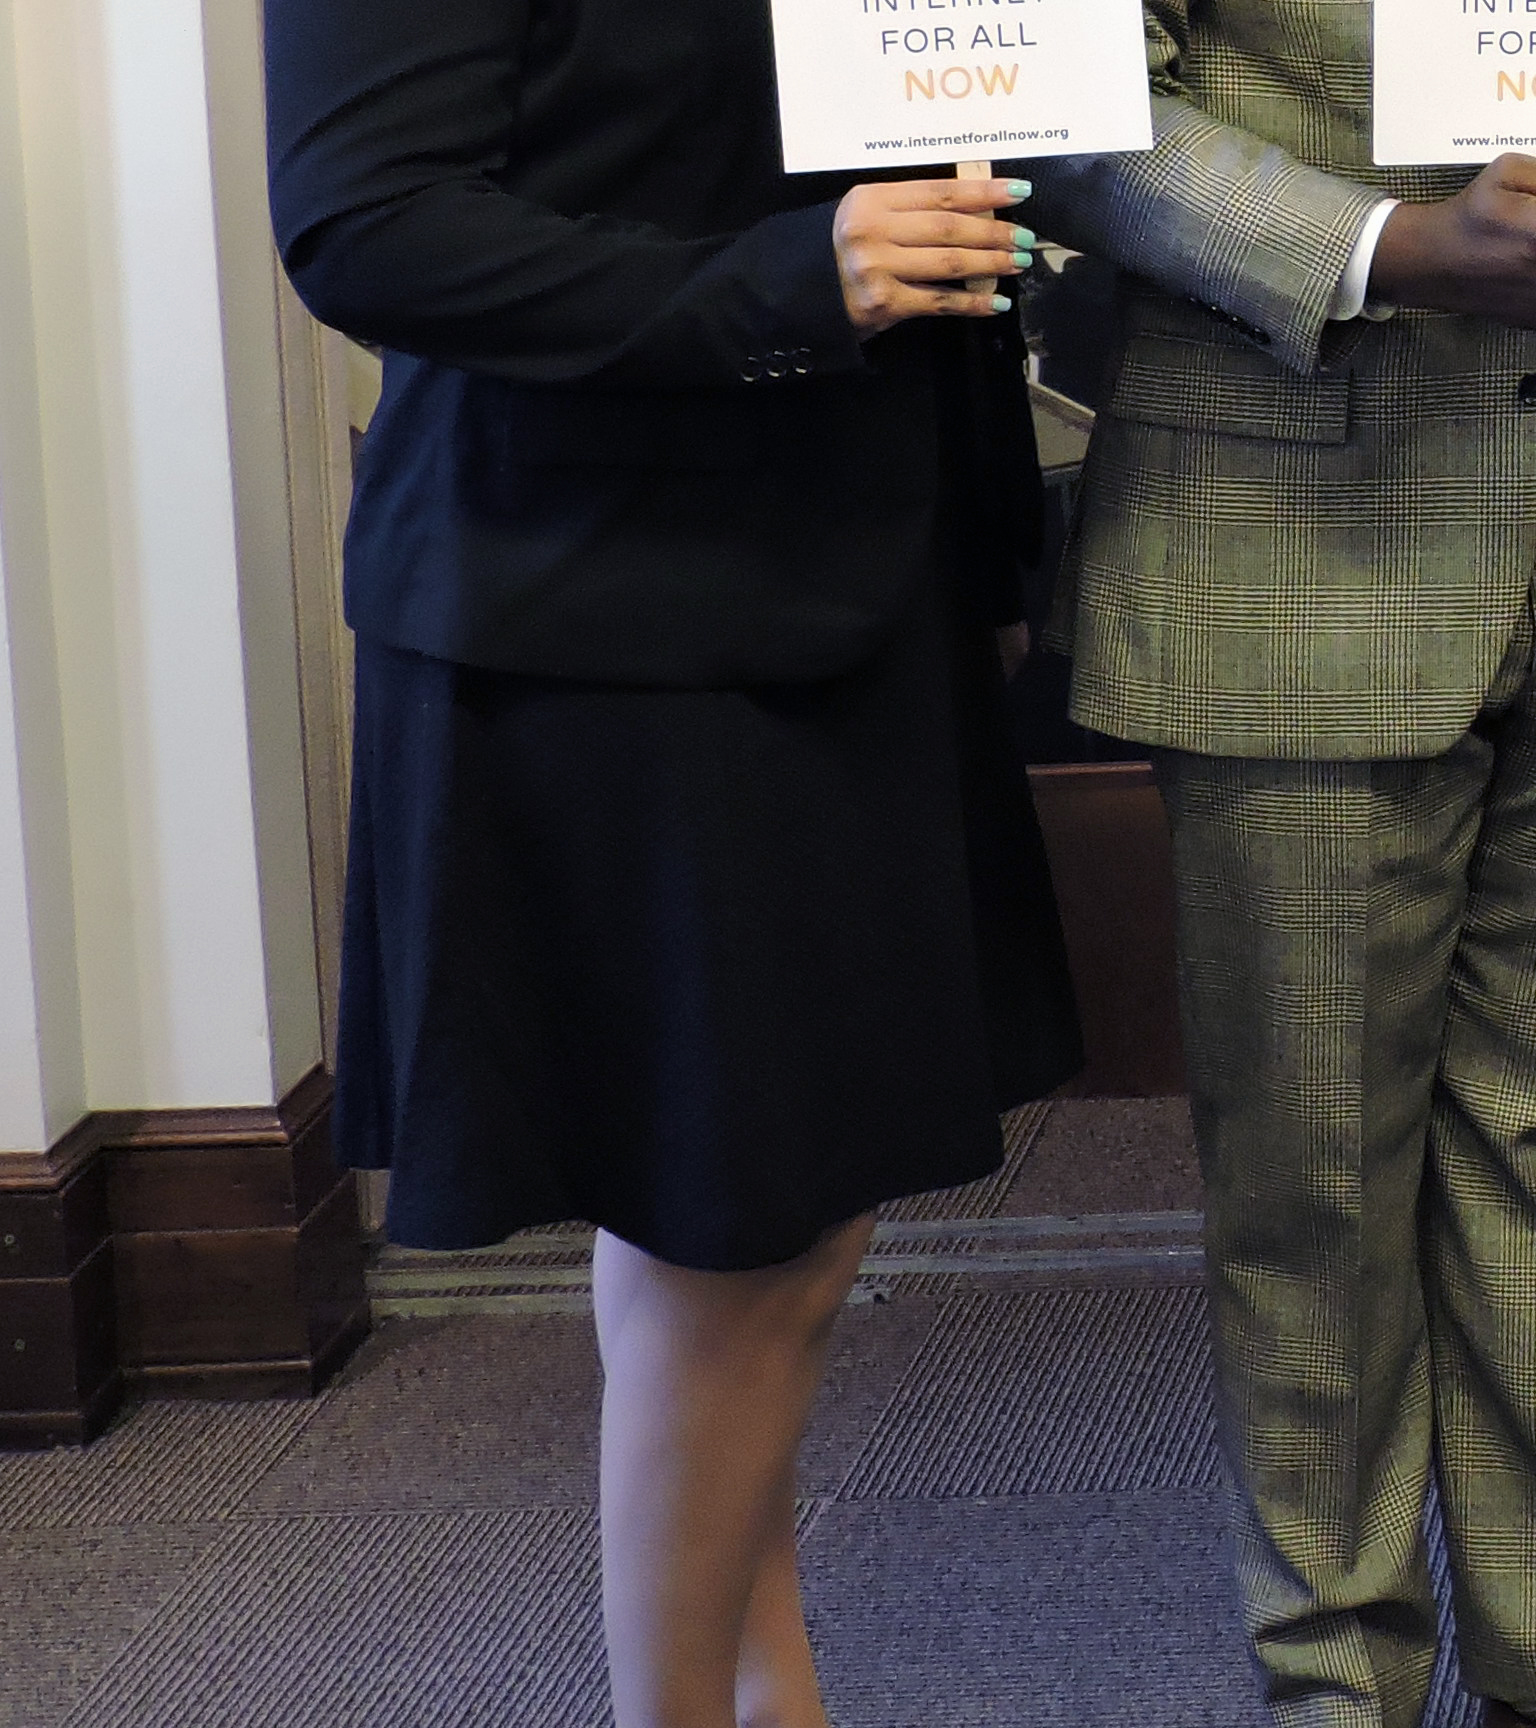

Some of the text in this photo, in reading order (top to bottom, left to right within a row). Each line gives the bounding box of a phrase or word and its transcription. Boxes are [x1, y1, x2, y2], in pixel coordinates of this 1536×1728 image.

[881, 21, 1038, 55] FOR ALL
[904, 63, 1019, 102] NOW
[864, 128, 1069, 150] www.internetforallnow.org
